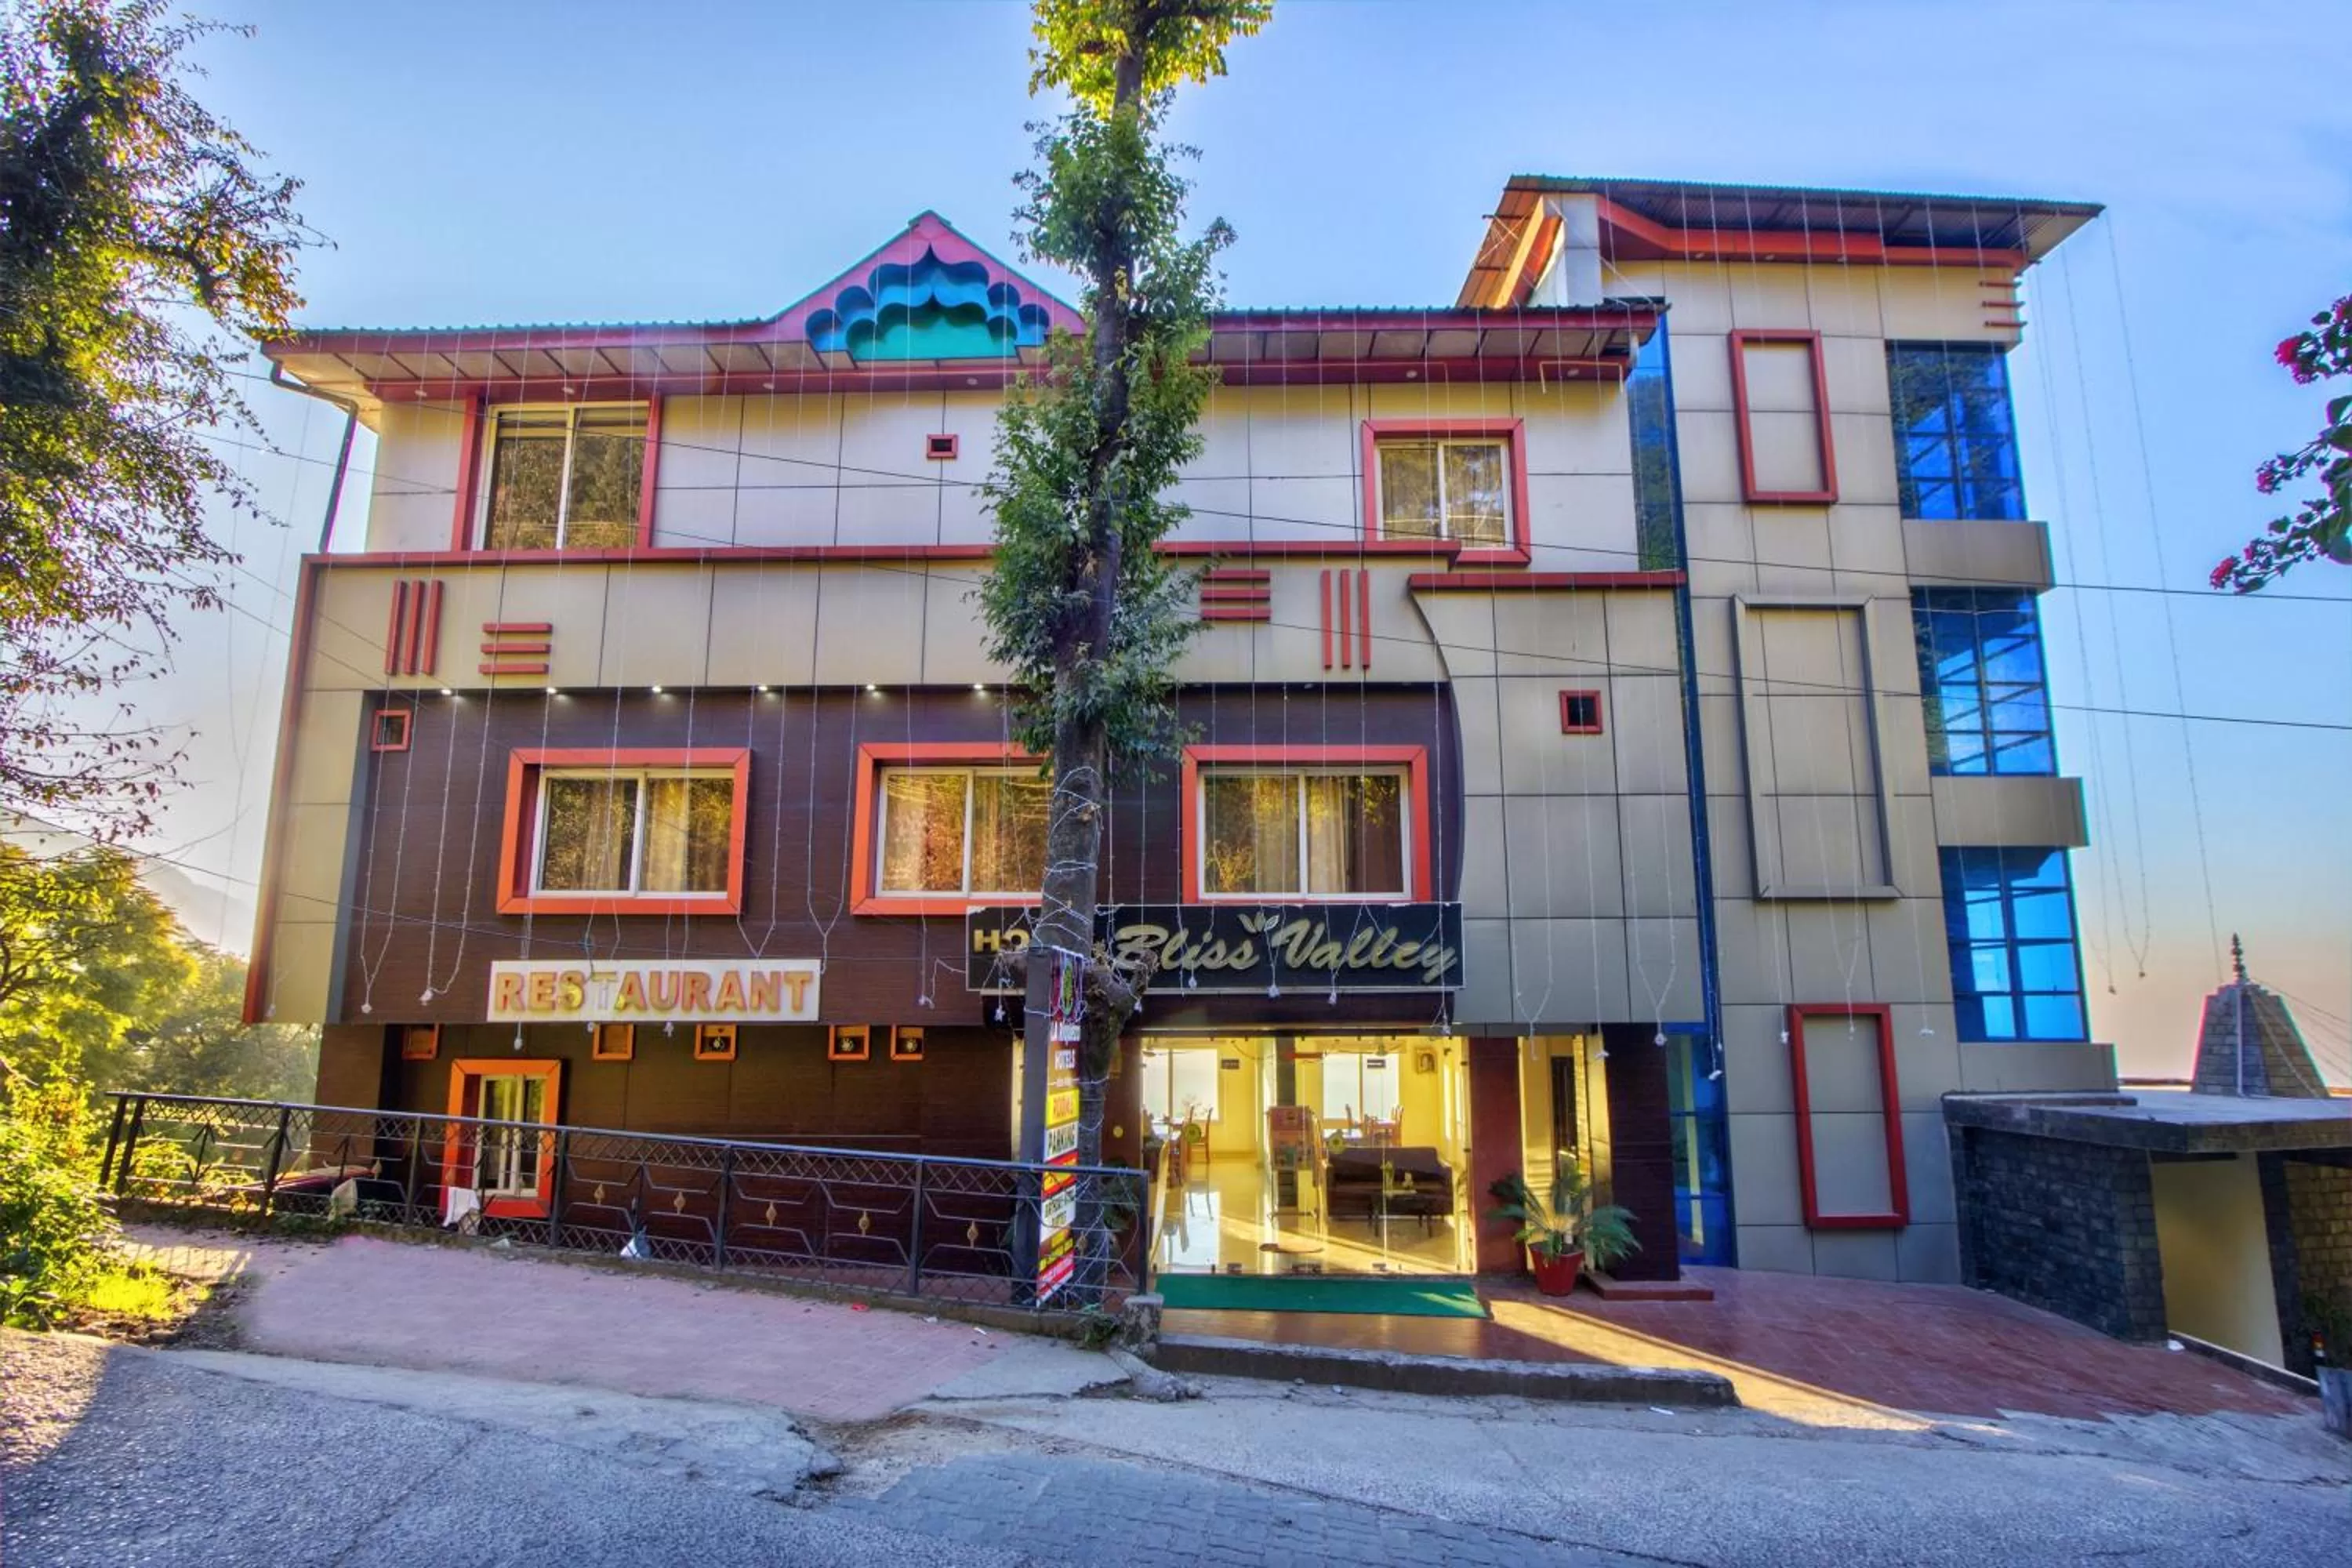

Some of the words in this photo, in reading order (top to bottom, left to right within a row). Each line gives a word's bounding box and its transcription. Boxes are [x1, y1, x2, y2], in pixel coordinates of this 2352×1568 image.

[1114, 924, 1260, 971] Bliss
[1272, 918, 1458, 984] Valley
[494, 970, 813, 1013] RESTAURANT
